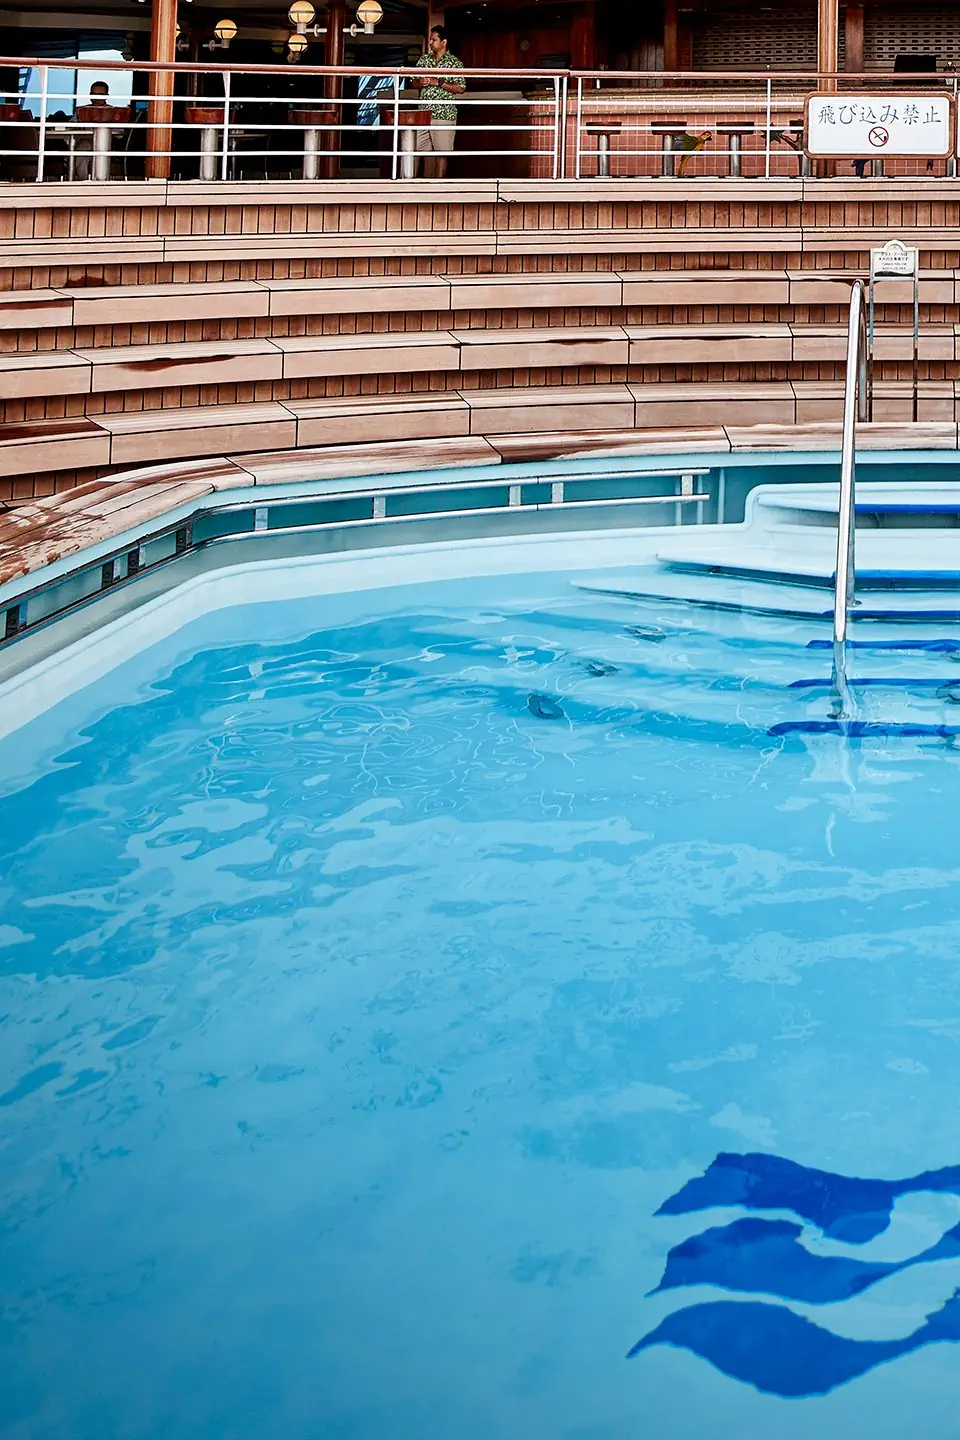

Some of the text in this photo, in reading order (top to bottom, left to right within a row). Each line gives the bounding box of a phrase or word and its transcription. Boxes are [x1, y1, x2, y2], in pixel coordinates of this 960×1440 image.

[817, 103, 942, 126] 飛び込み禁止
